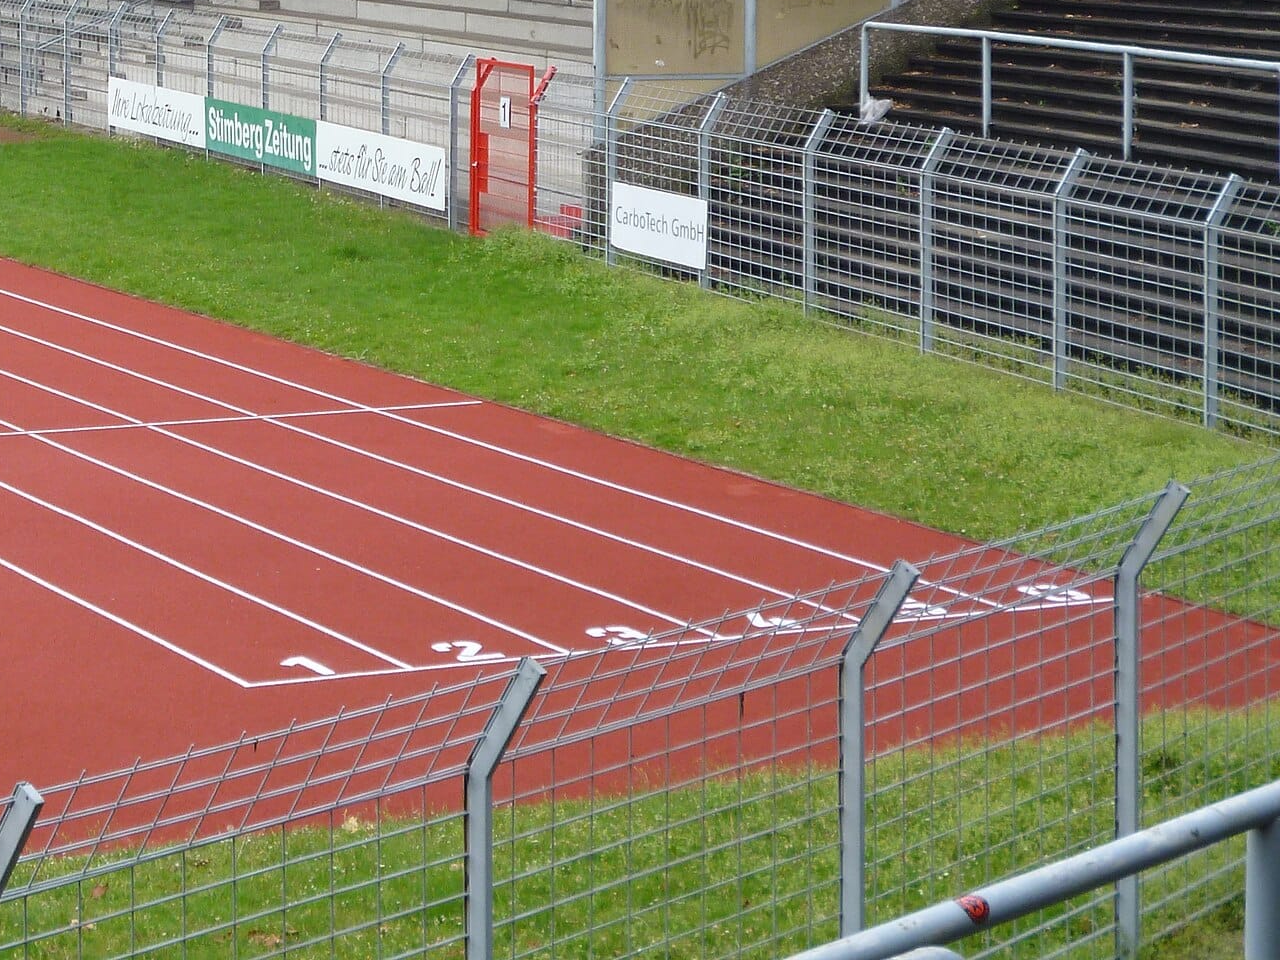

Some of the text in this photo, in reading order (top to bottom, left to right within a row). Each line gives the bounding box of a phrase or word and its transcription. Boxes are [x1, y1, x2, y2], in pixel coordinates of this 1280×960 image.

[208, 106, 312, 171] Stimberg Zeitung
[372, 148, 388, 184] Sie
[388, 164, 407, 190] am
[410, 157, 442, 197] Ball!
[615, 206, 705, 243] CarboTech GmbH
[585, 626, 658, 645] 3
[430, 640, 506, 662] 2
[279, 656, 336, 676] 1
